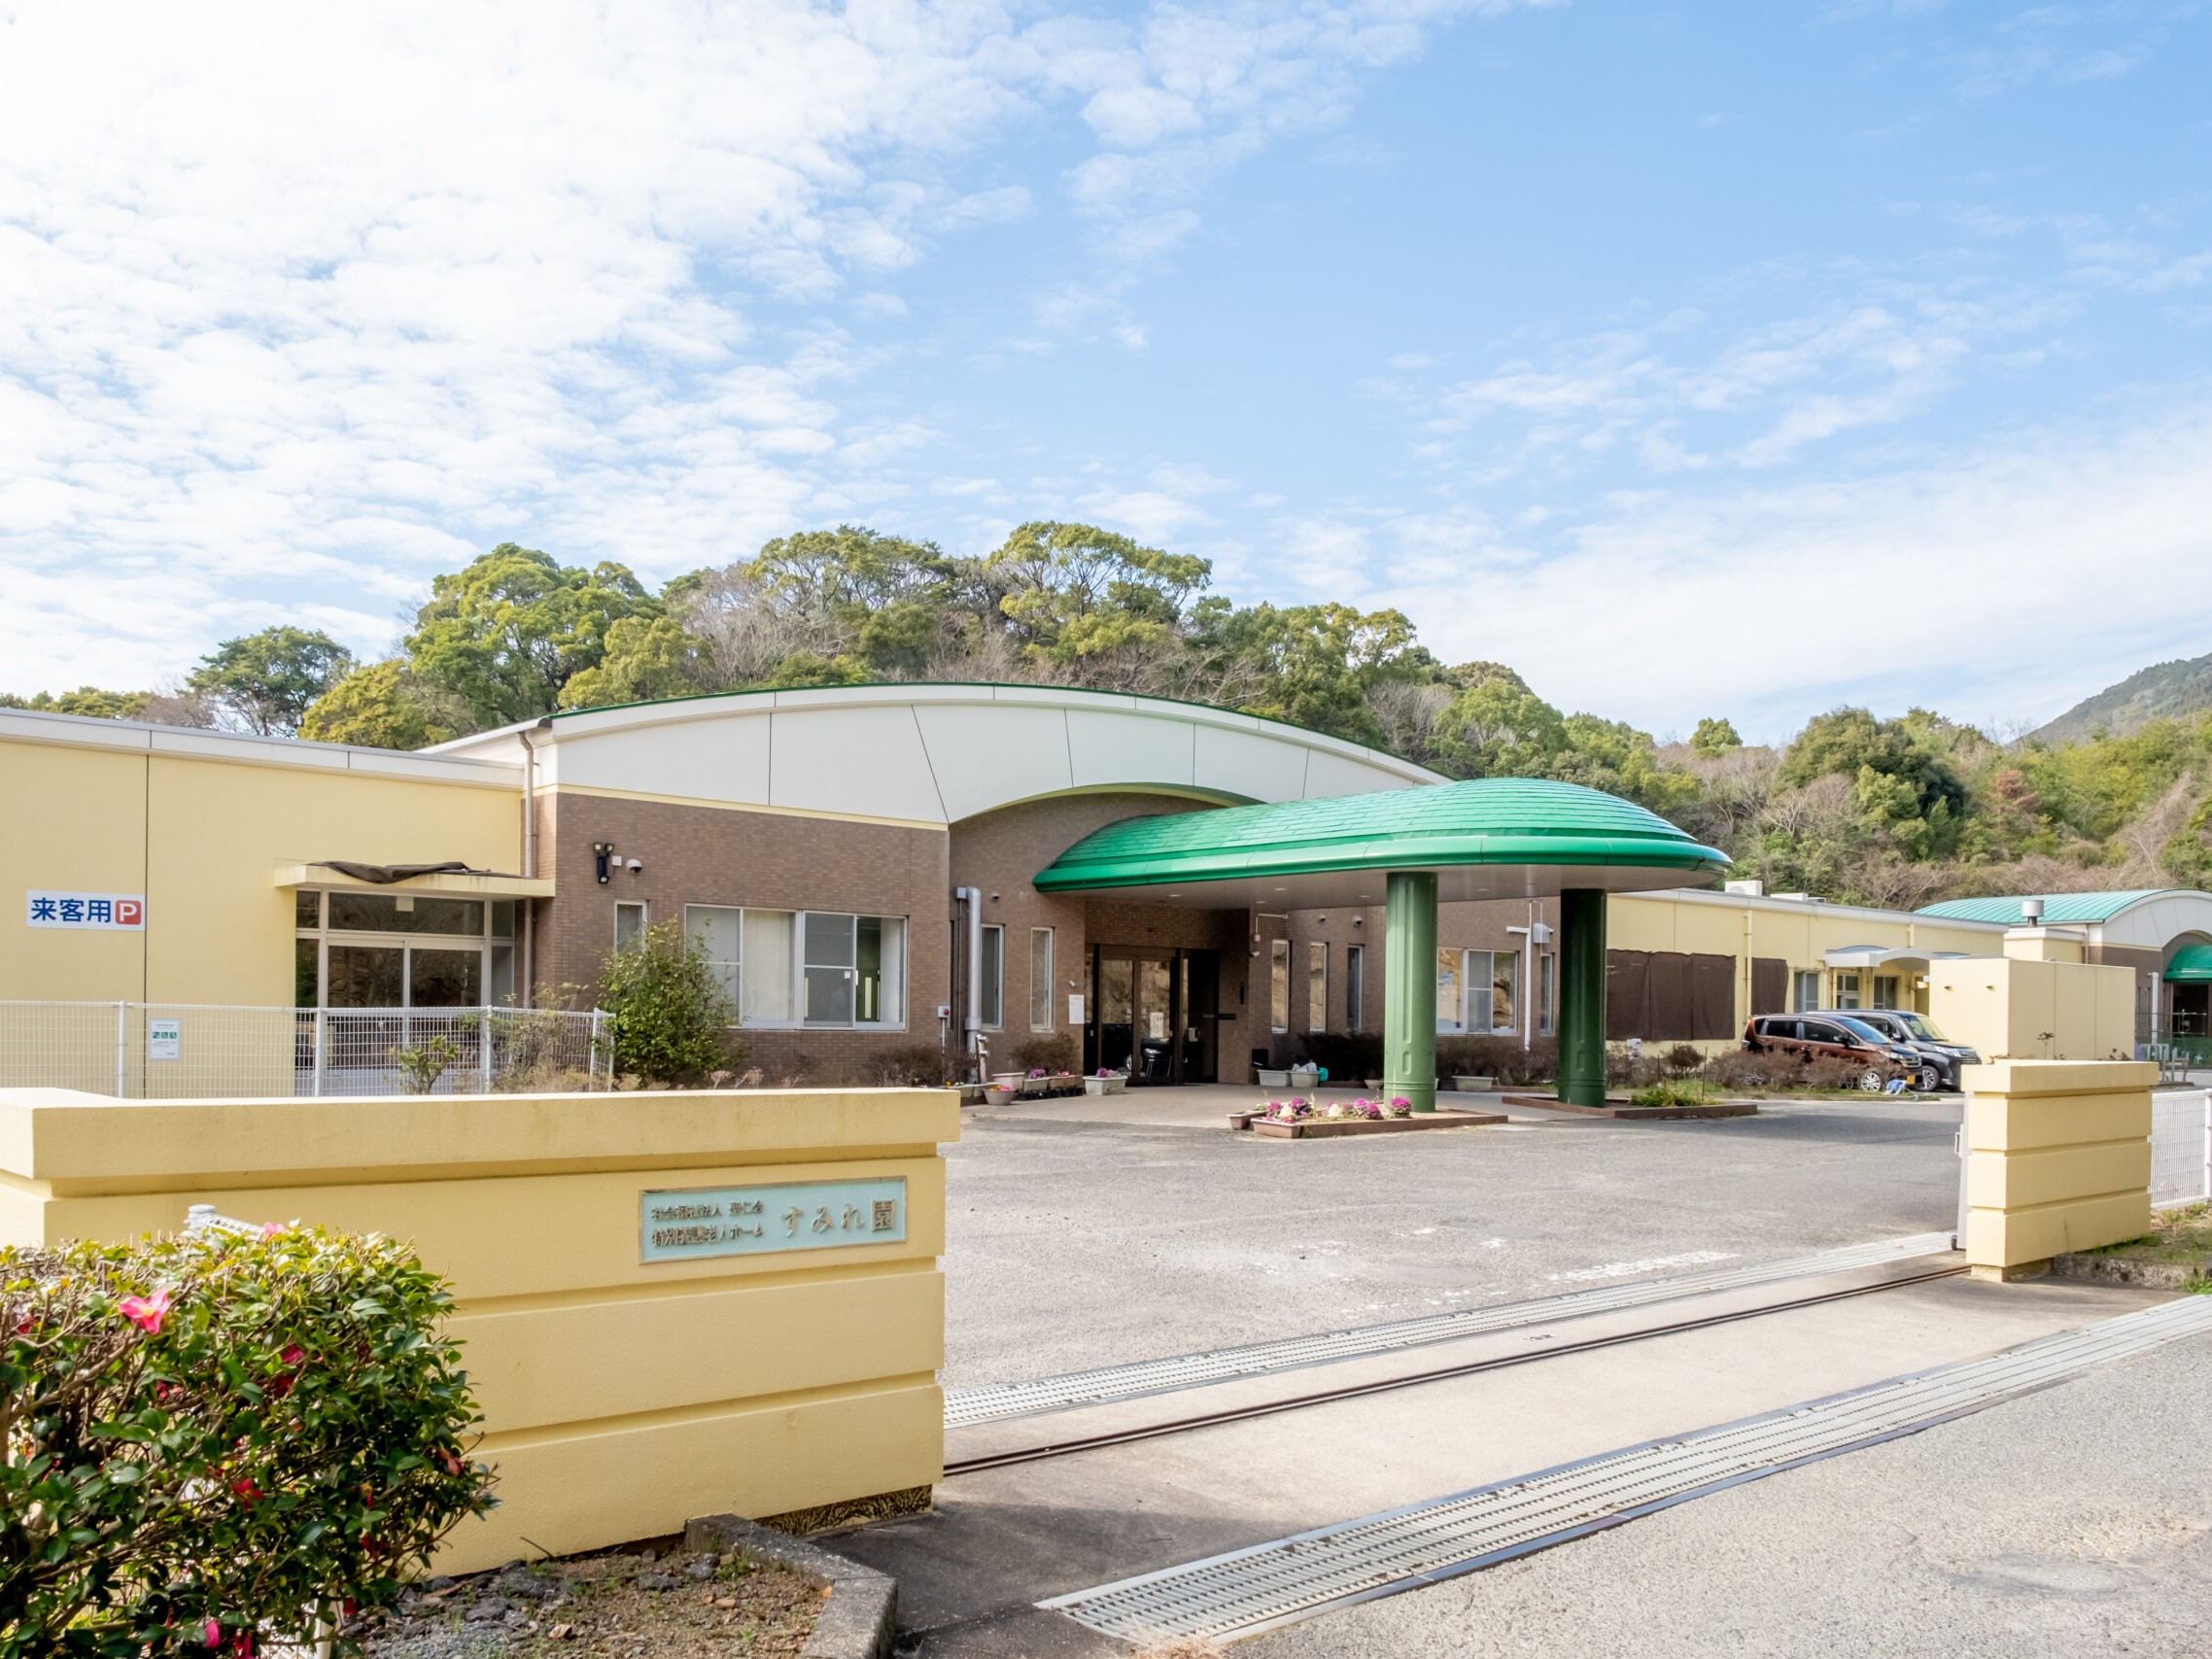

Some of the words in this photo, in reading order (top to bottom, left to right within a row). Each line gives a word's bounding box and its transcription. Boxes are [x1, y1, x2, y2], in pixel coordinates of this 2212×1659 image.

[30, 896, 112, 923] 来客用
[120, 903, 138, 922] P
[779, 1198, 896, 1237] すみれ園
[651, 1223, 764, 1248] 特別養護老人ホーム
